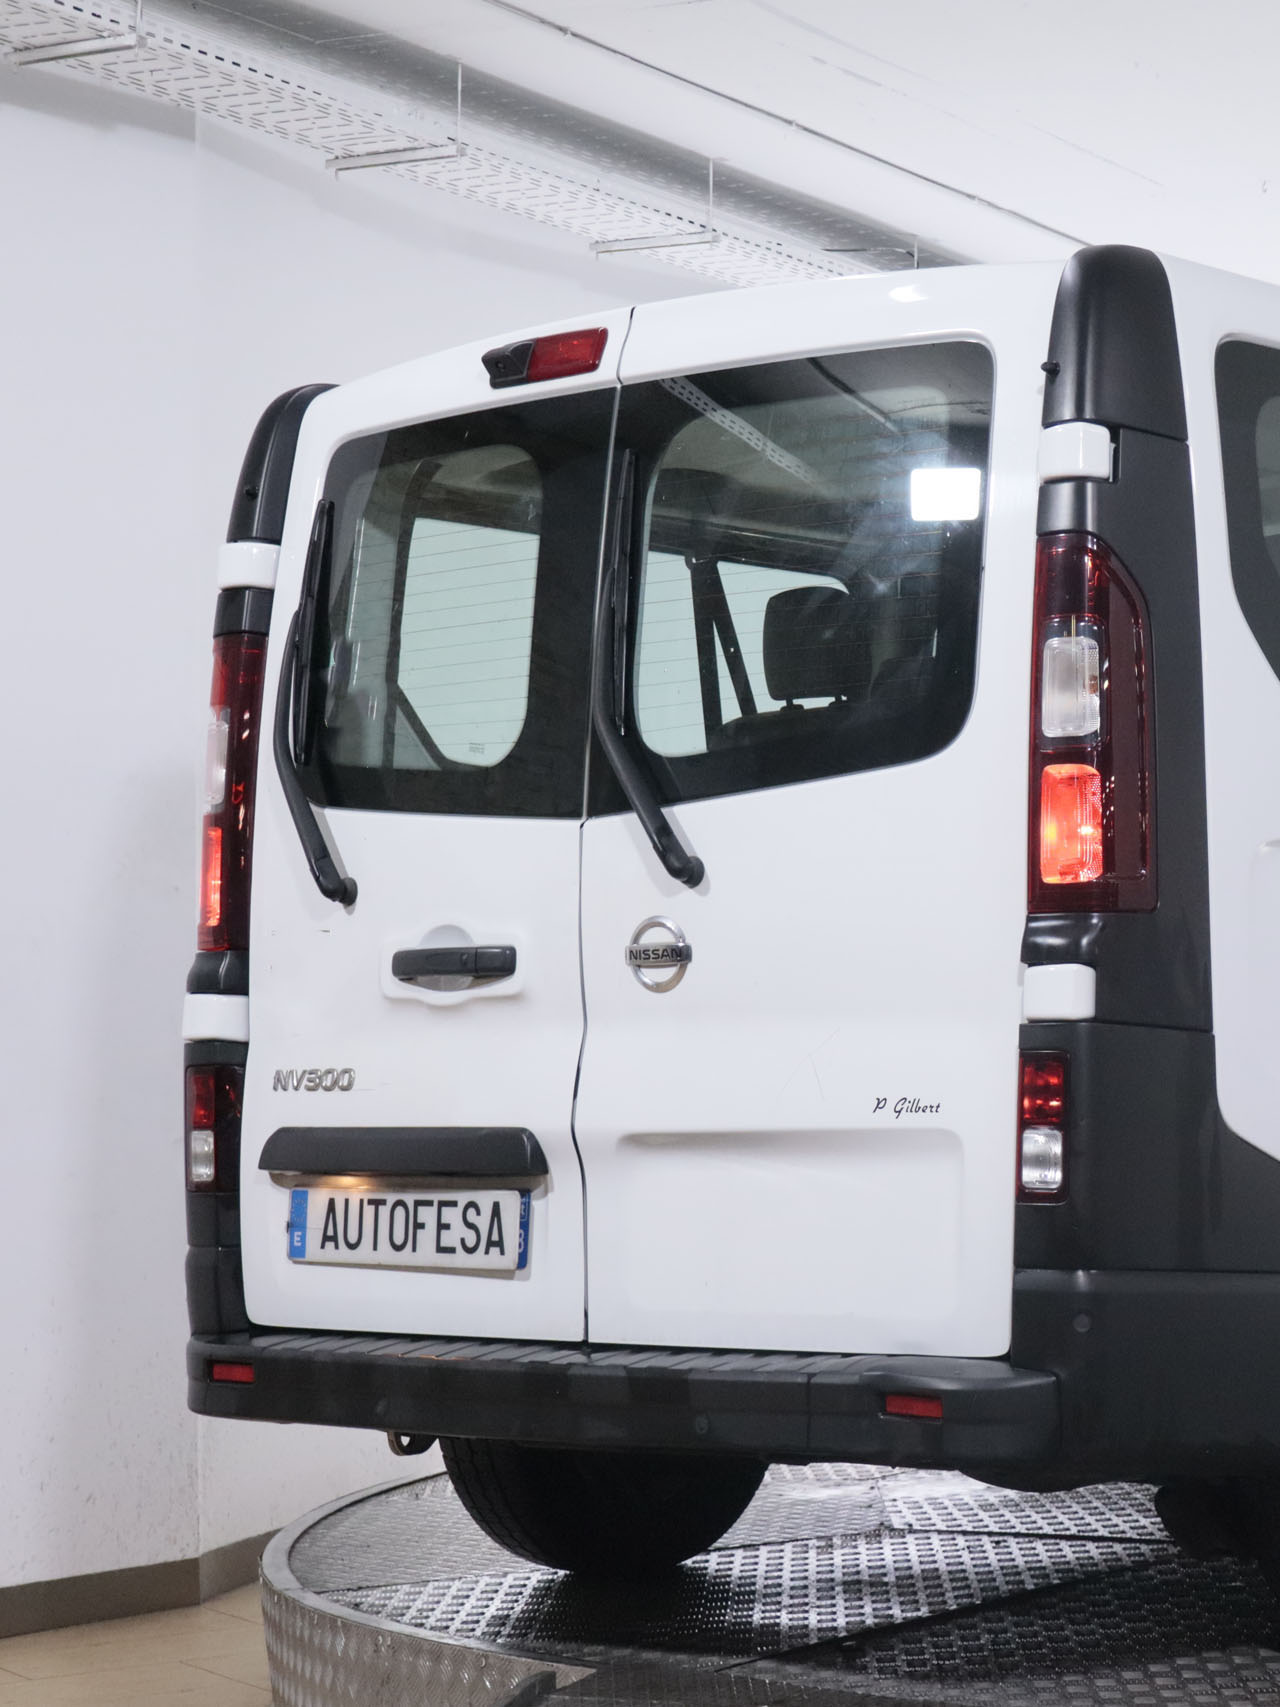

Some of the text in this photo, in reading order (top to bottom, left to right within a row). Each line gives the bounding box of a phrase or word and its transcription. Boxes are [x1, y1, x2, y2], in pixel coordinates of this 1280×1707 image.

[629, 947, 682, 961] NISSAN
[272, 1068, 356, 1092] NV300
[893, 1096, 941, 1120] Gilbert
[293, 1231, 302, 1246] E
[320, 1197, 506, 1257] AUTOFESA
